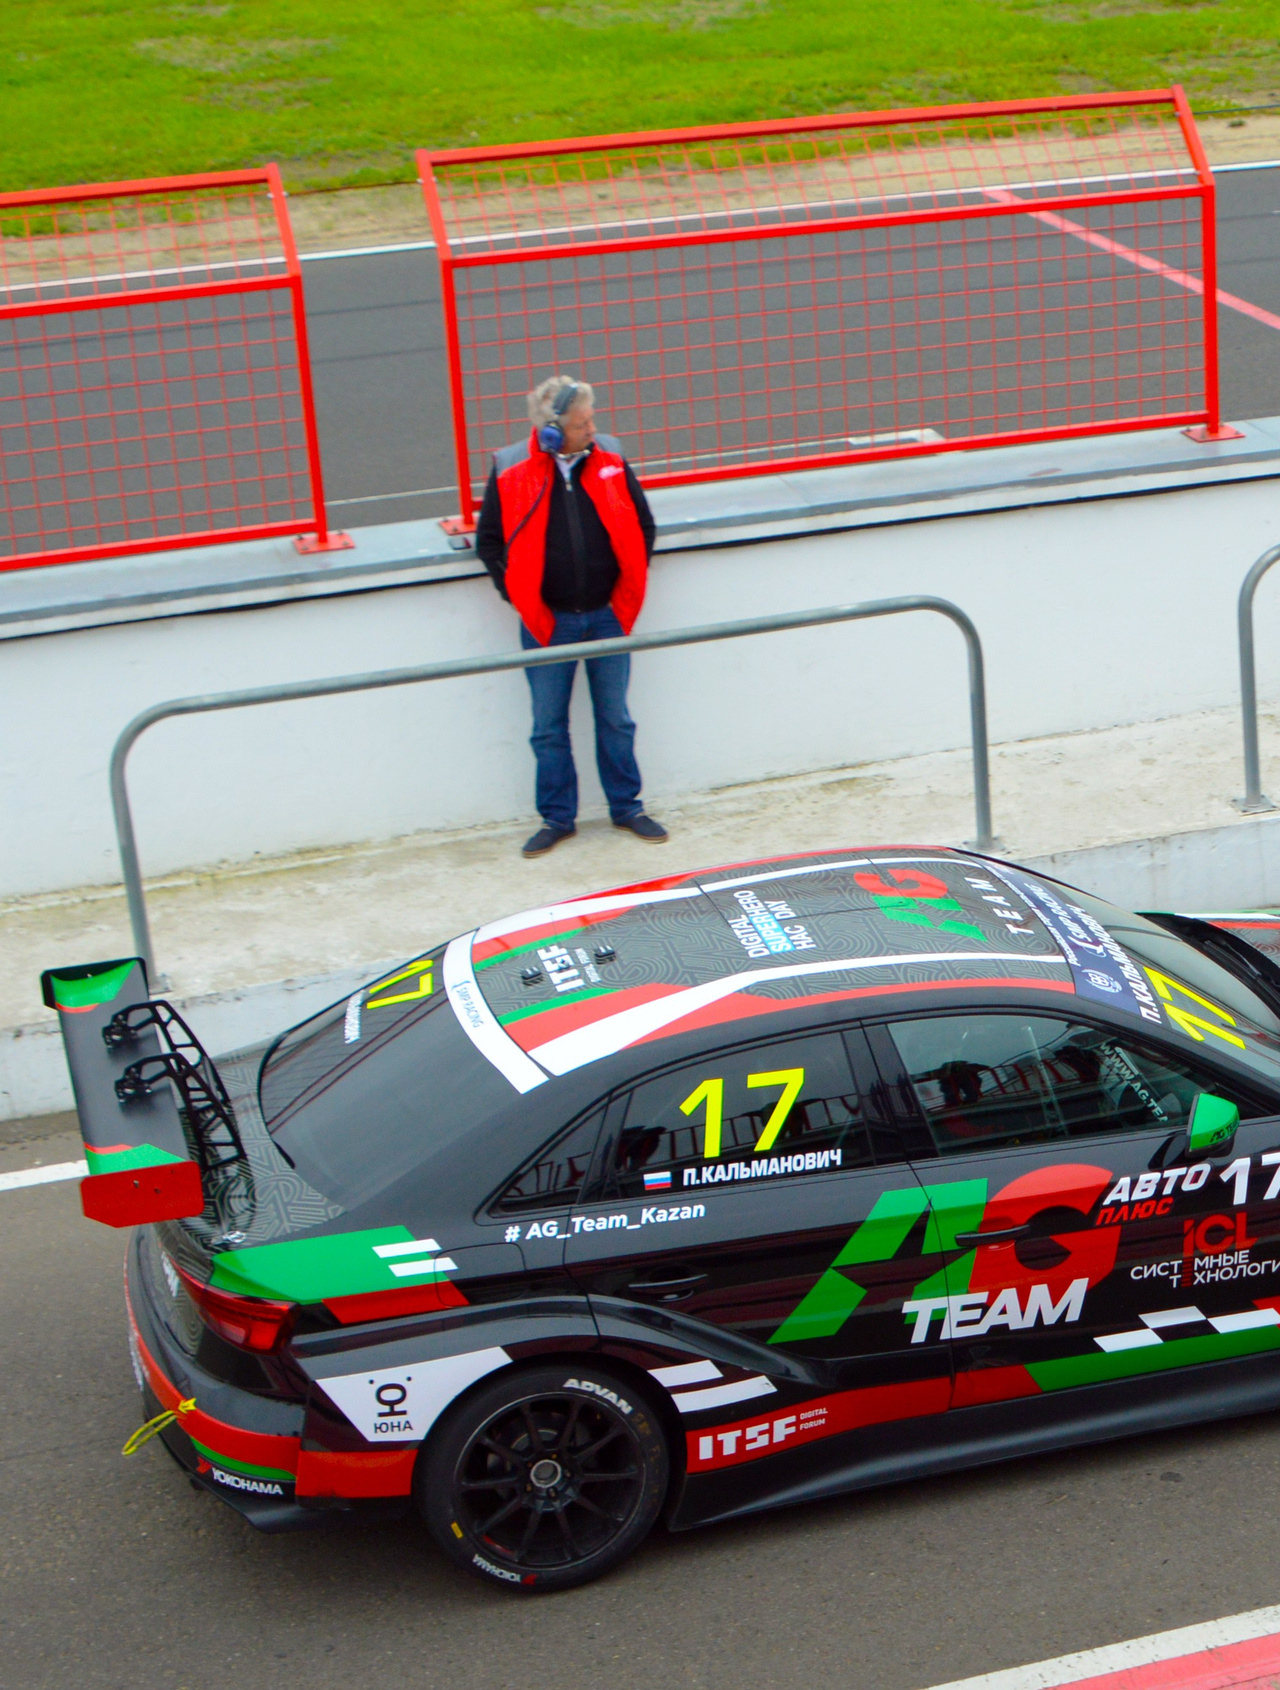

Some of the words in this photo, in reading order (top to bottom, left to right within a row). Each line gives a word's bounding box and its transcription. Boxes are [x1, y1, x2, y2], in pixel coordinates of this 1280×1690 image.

[733, 890, 792, 953] SUPERHERO
[764, 901, 798, 920] DAY
[964, 877, 1035, 935] TEAM
[727, 914, 771, 958] DIGITAL
[783, 925, 817, 950] HAC
[537, 945, 586, 993] ITSF
[1142, 966, 1247, 1050] 17
[678, 1067, 805, 1159] 17
[682, 1148, 842, 1187] П.КАЛЬМАНОВИЧ
[1102, 1163, 1212, 1206] АВТО
[1095, 1197, 1174, 1226] ПЛЮС
[766, 1163, 1122, 1345] AG
[1183, 1211, 1259, 1257] ICL
[901, 1277, 1089, 1344] TEAM
[562, 1379, 634, 1415] ADVAN
[800, 1407, 829, 1420] DIGITAL
[374, 1420, 413, 1434] ЮНА
[699, 1415, 797, 1460] ITSF
[799, 1418, 826, 1431] FORUM
[211, 1467, 284, 1495] YOKOHAMA
